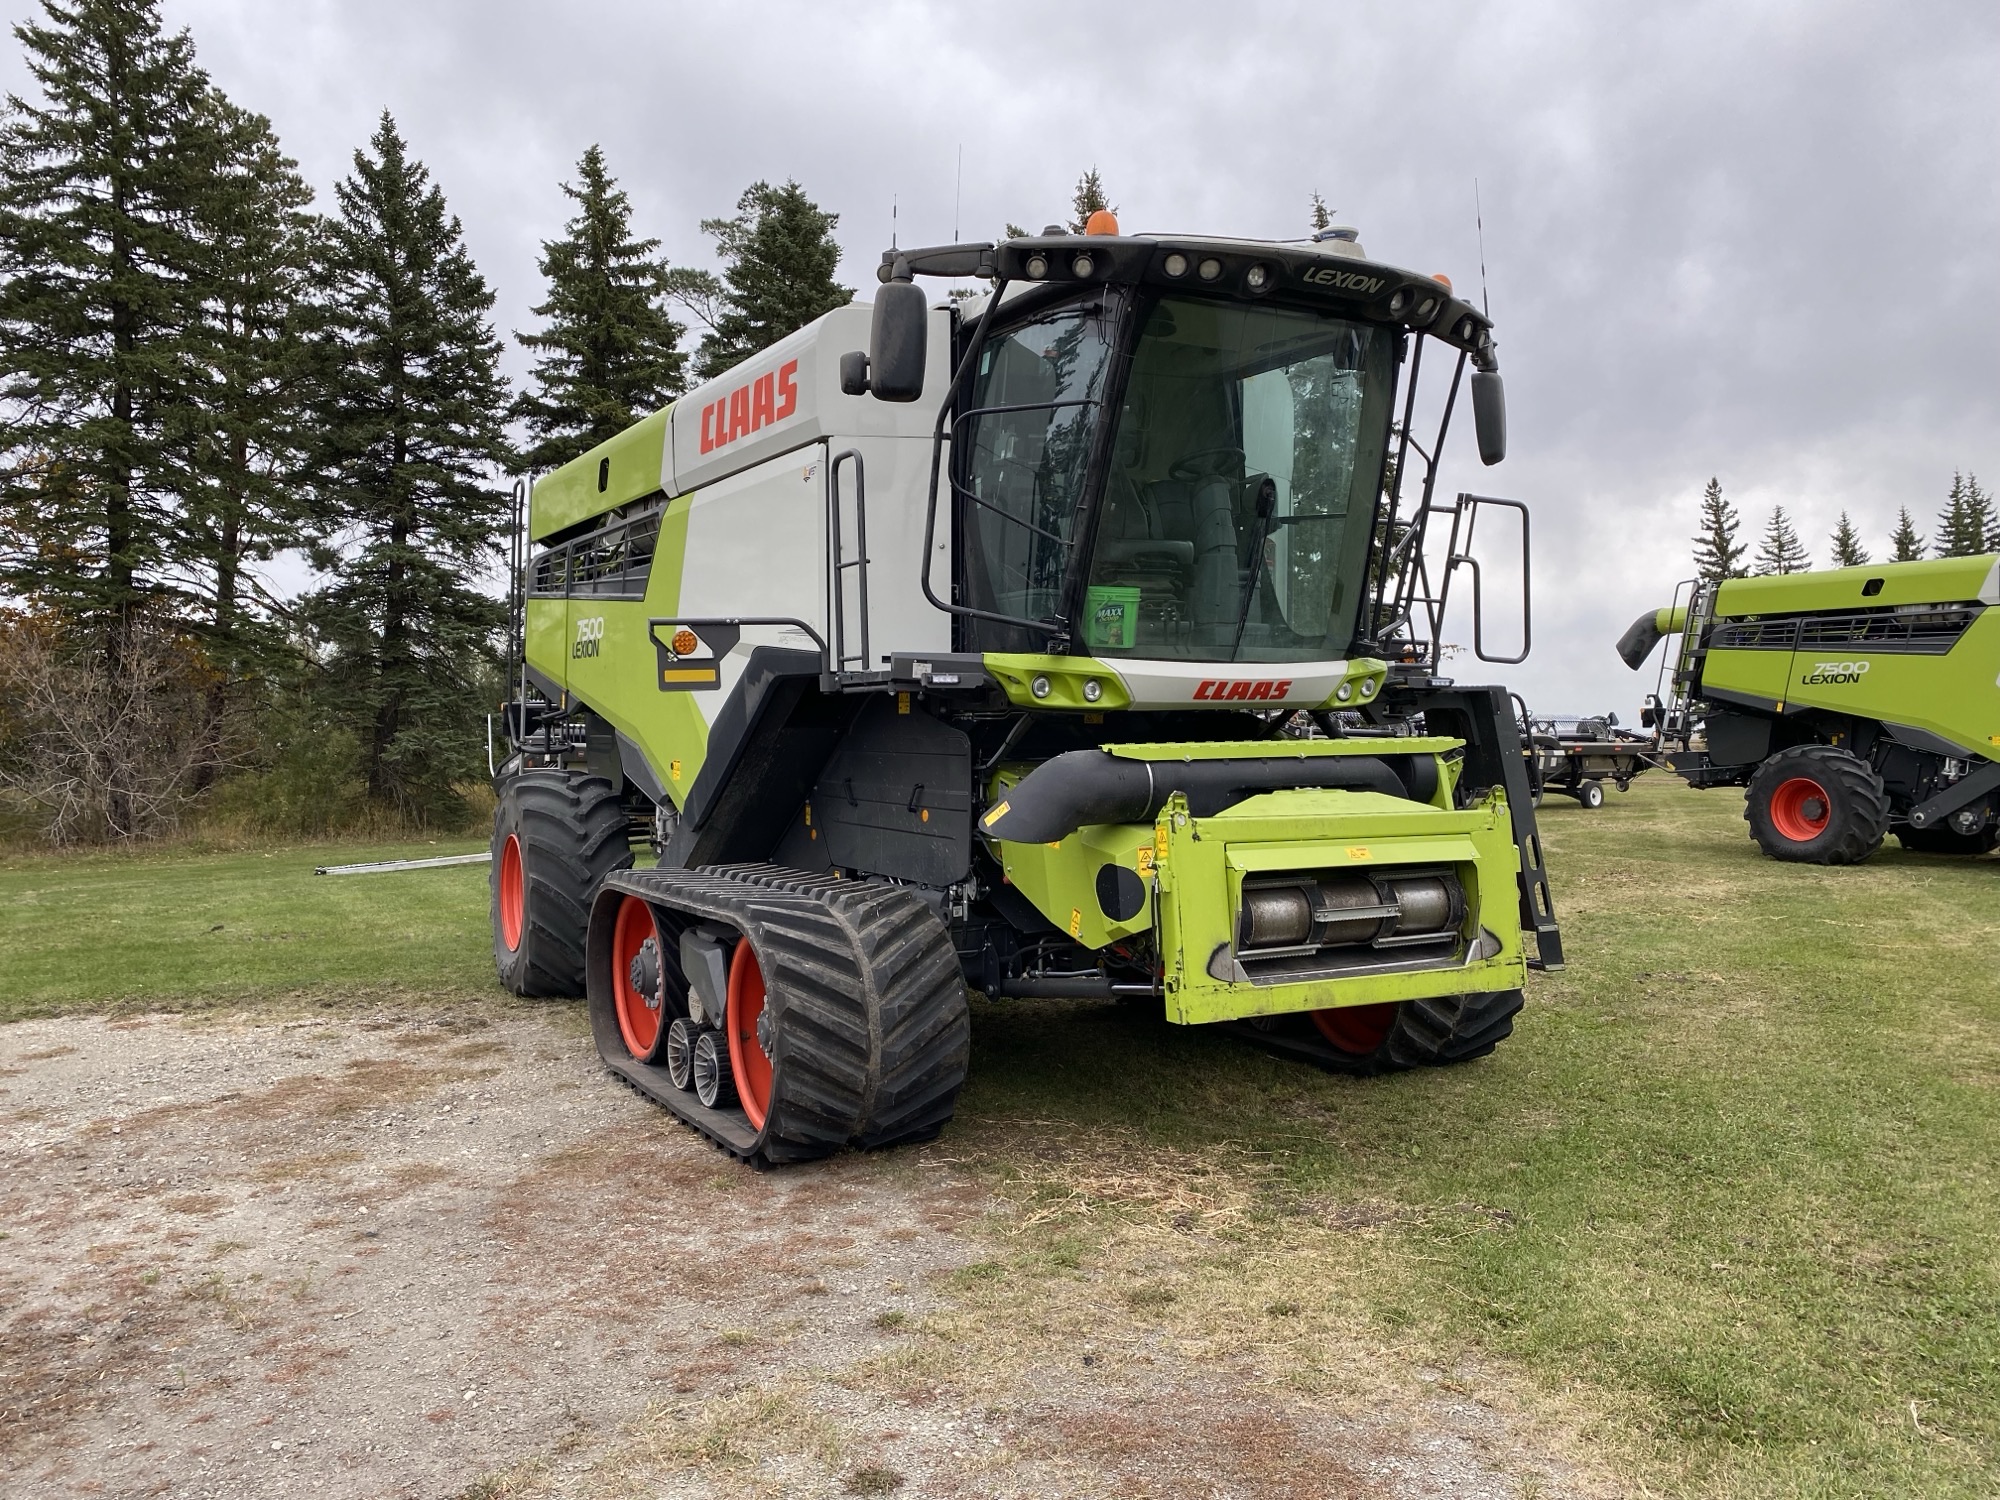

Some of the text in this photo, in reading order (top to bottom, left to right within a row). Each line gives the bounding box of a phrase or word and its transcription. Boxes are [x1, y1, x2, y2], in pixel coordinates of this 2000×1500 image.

[1303, 267, 1386, 294] LEXION
[700, 358, 798, 455] CLAAS
[1096, 607, 1124, 618] MAXX
[576, 616, 604, 642] 7500
[572, 639, 600, 660] LEXION
[1813, 661, 1870, 675] 7500
[1801, 673, 1861, 685] LEXION
[1192, 680, 1293, 700] CLAAS
